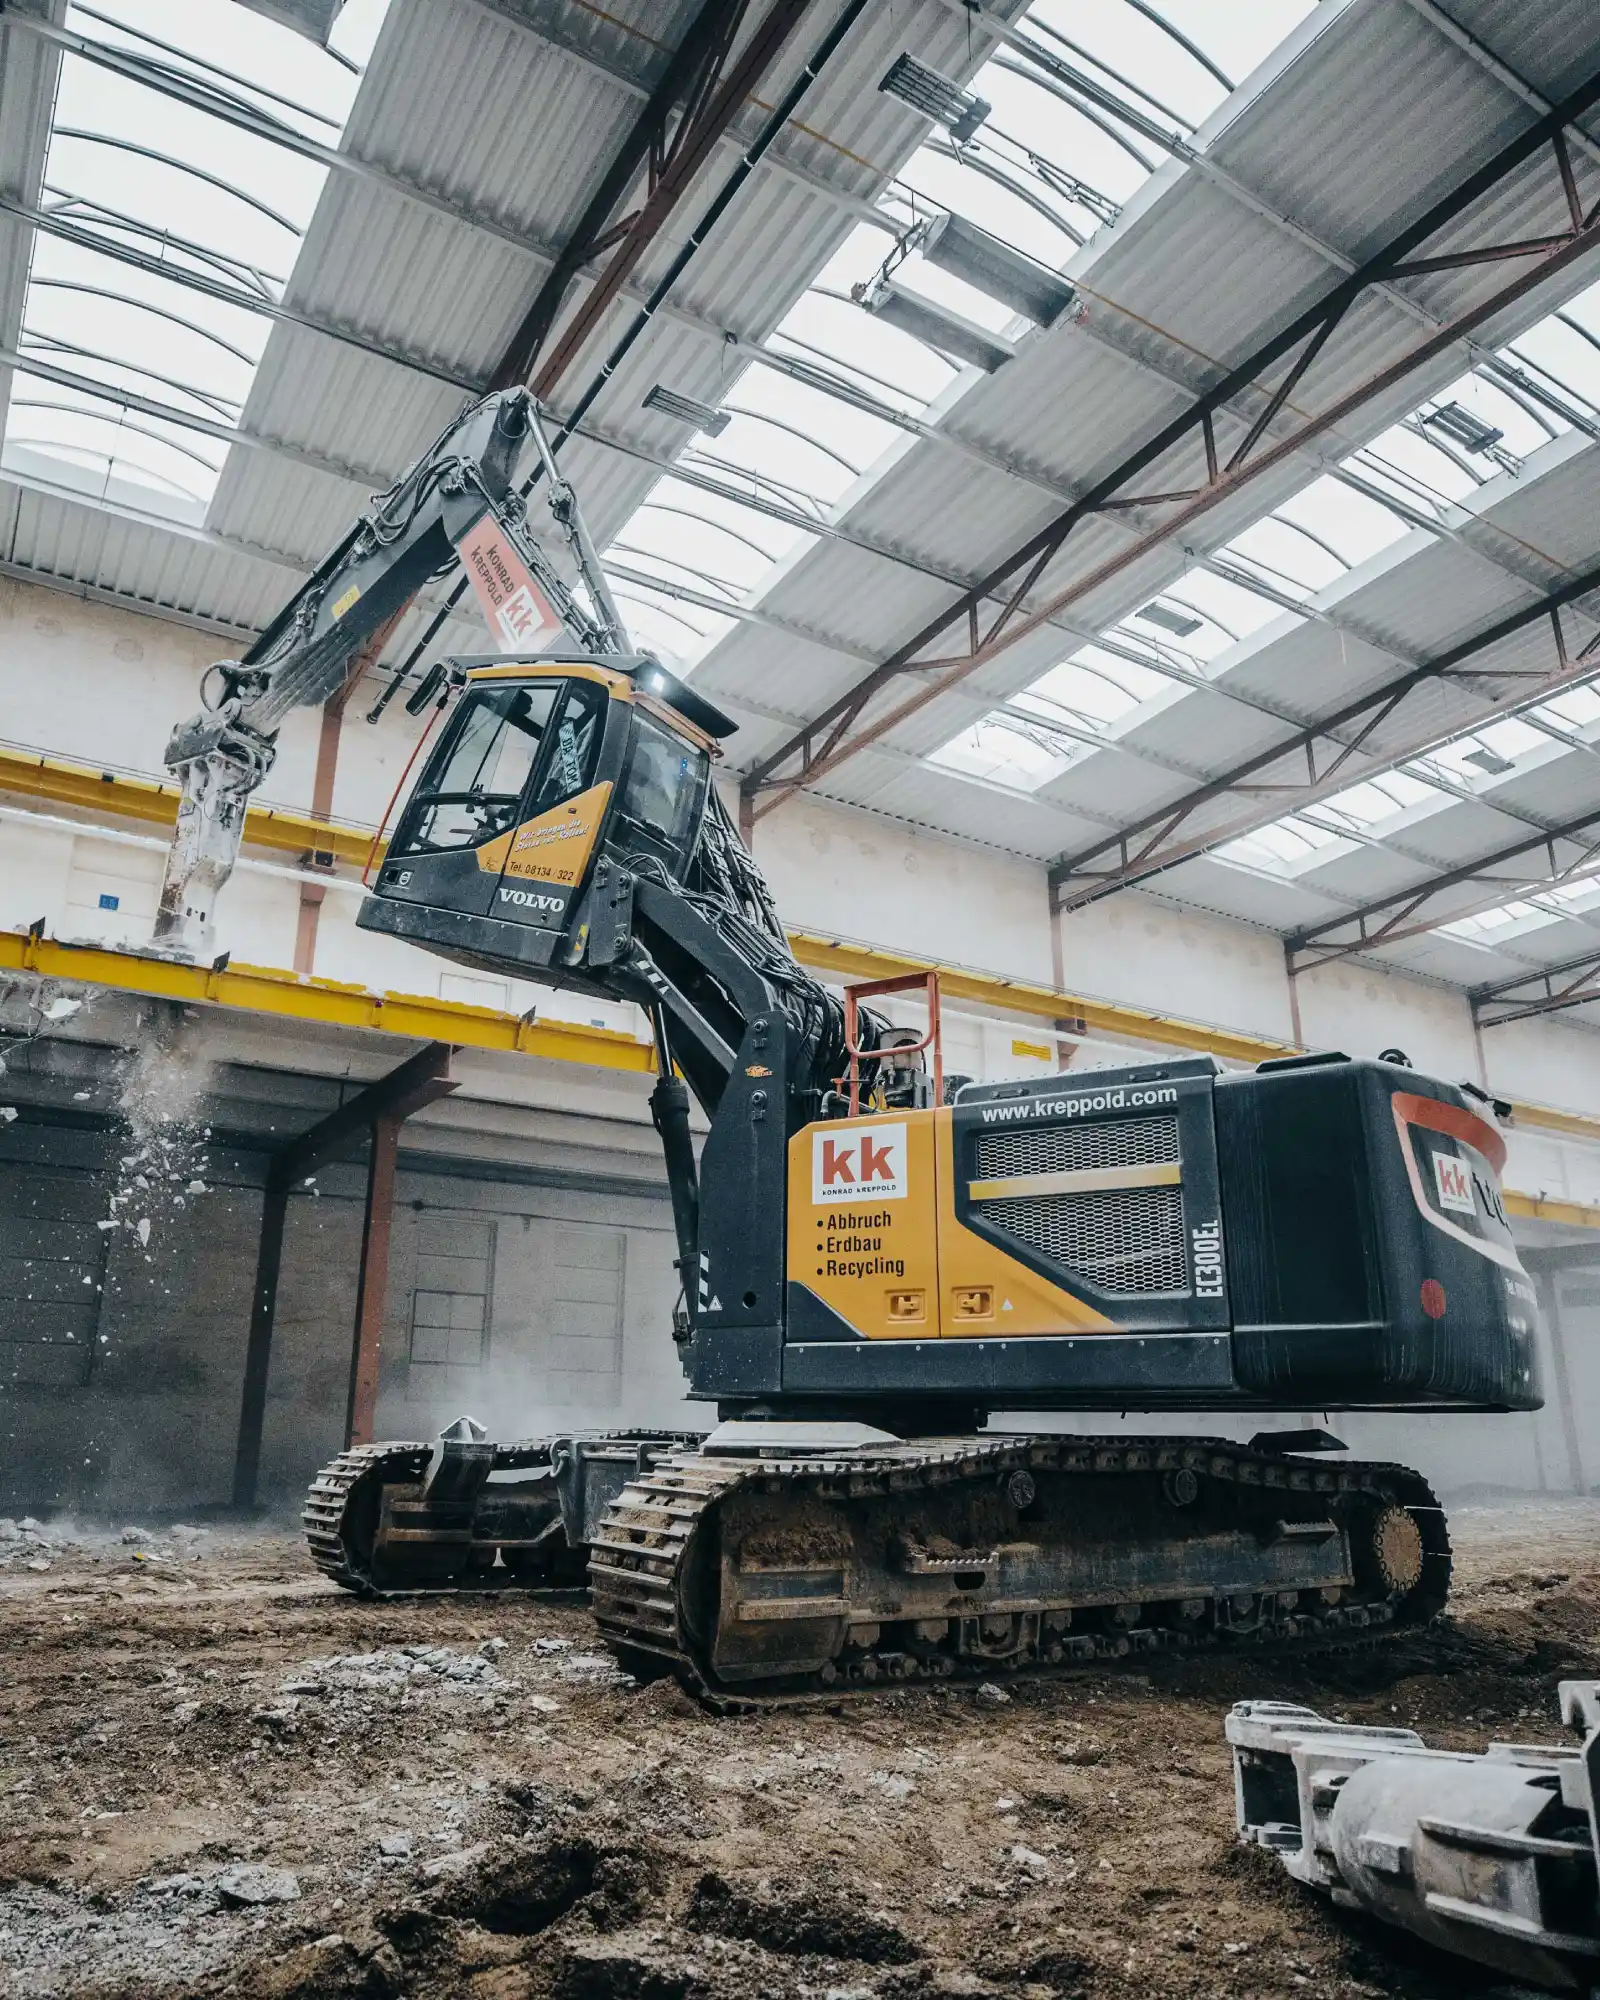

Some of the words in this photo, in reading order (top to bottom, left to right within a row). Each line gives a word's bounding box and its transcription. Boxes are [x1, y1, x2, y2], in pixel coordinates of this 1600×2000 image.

[510, 861, 522, 873] Tel.
[524, 864, 551, 877] 08134
[557, 870, 574, 881] 322
[499, 888, 564, 913] VOLVO
[982, 1087, 1177, 1122] www.kreppold.com
[823, 1136, 895, 1184] kk
[1437, 1159, 1469, 1199] kk
[827, 1210, 892, 1230] Abbruch
[827, 1235, 881, 1253] Erdbau
[827, 1257, 904, 1279] Recycling
